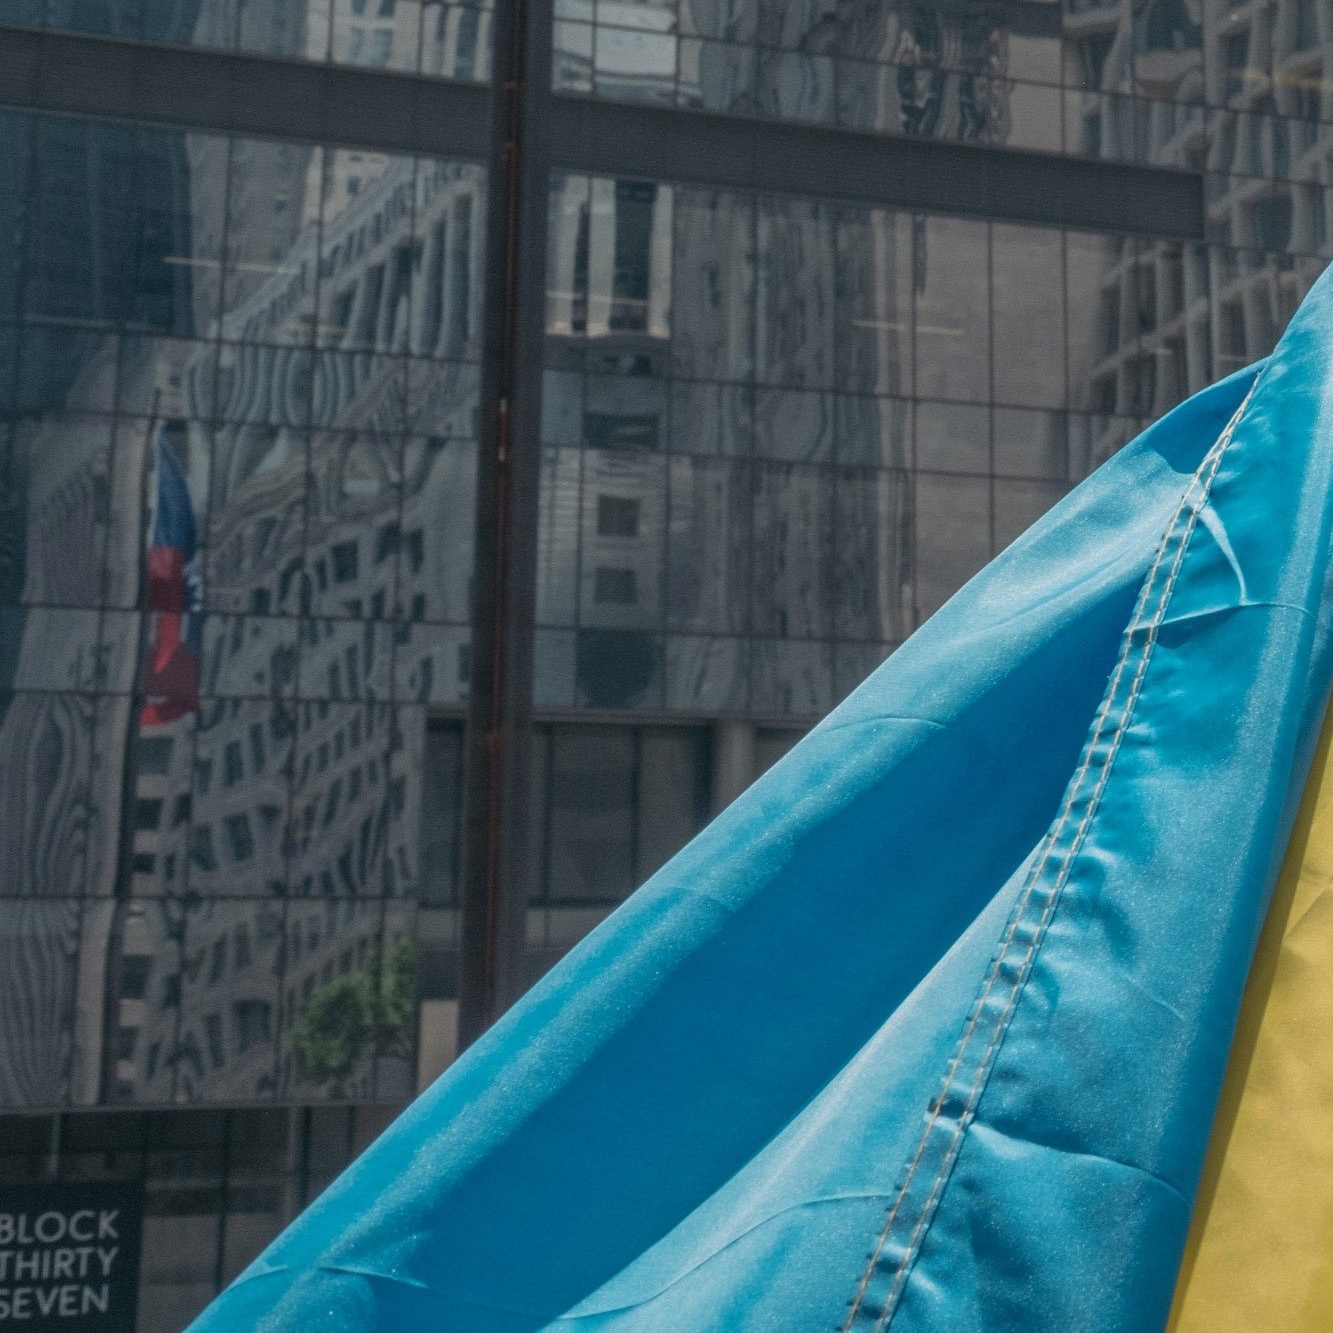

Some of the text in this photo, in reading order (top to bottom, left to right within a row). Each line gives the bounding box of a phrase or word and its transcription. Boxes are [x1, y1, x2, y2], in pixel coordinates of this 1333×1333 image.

[0, 1210, 119, 1243] BLOCK
[0, 1247, 119, 1281] THIRTY
[0, 1285, 109, 1320] SEVEN
